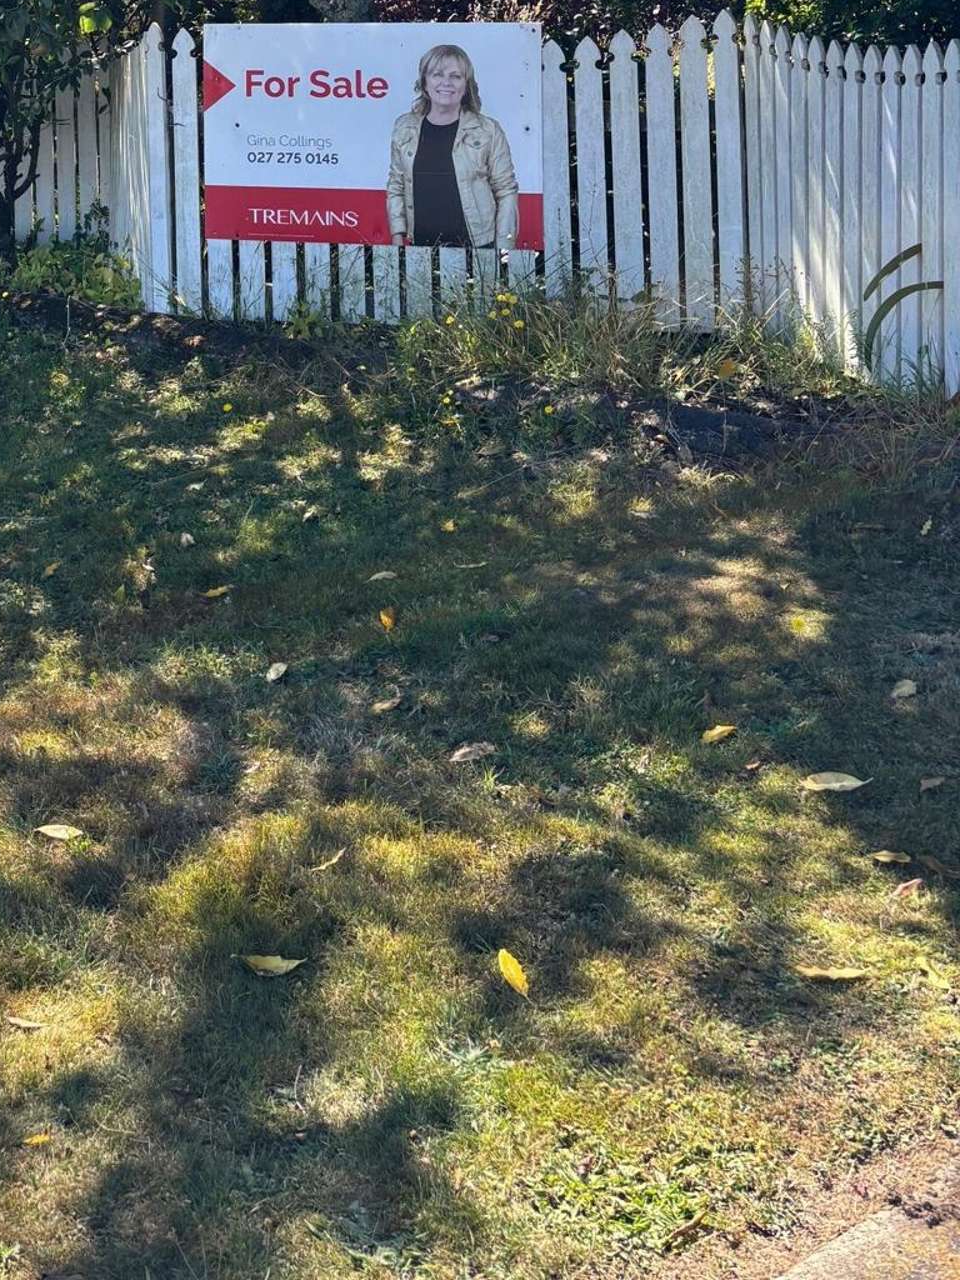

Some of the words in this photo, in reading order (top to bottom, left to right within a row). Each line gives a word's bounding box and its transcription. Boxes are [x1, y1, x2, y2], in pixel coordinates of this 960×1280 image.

[245, 69, 300, 98] For
[309, 69, 389, 99] Sale
[246, 134, 276, 147] Gina
[279, 134, 333, 151] Collings
[247, 151, 274, 164] 027
[276, 151, 302, 165] 275
[305, 152, 339, 165] 0145
[247, 208, 360, 228] TREMAINS
